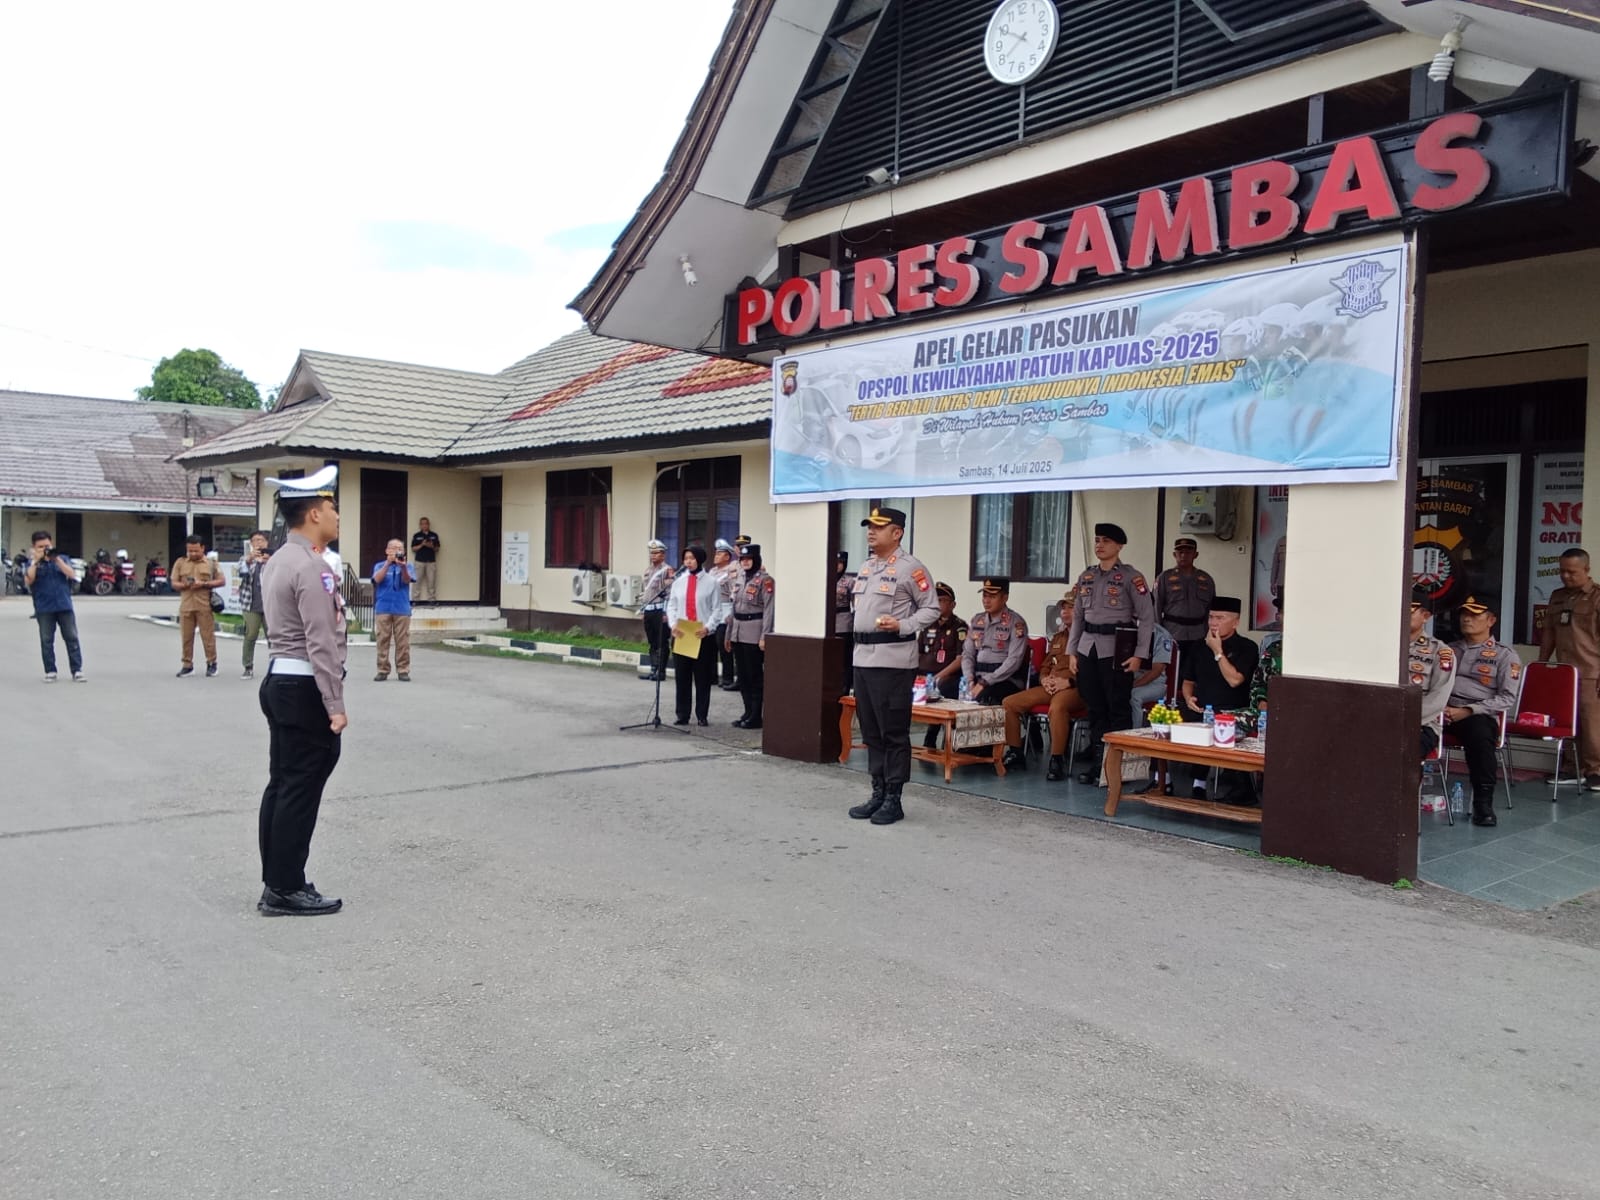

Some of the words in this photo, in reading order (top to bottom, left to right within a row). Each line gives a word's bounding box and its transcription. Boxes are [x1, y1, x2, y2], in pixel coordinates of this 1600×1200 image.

[1031, 3, 1036, 13] 1
[1038, 11, 1046, 23] 2
[1041, 24, 1049, 36] 3
[996, 40, 1003, 52] 9
[1037, 40, 1046, 51] 4
[998, 54, 1006, 65] 8
[1029, 54, 1037, 66] 5
[1008, 61, 1015, 73] 7
[1018, 62, 1025, 74] 6
[738, 236, 980, 345] POLRES
[999, 113, 1490, 295] SAMBAS
[914, 336, 957, 368] APEL
[961, 324, 1025, 362] GELAR
[1028, 306, 1139, 352] PASUKAN
[858, 375, 908, 401] OPSPOL
[911, 360, 1016, 394] KEWILAYAHAN
[1019, 351, 1074, 380] PATUH
[1077, 330, 1219, 372] KAPUAS-2025
[885, 399, 932, 418] BERLALU
[932, 394, 970, 414] LINTAS
[972, 388, 1005, 409] DEMI
[1006, 376, 1100, 404] TERWUJUDNYA
[1101, 367, 1186, 394] INDONESIA
[923, 419, 937, 434] Di
[937, 413, 981, 434] Wilayah
[981, 411, 1019, 429] Hukum
[1021, 408, 1057, 426] Polres
[1059, 400, 1109, 422] Sambas
[959, 465, 995, 479] Sambas,
[998, 464, 1008, 474] 14
[1010, 462, 1027, 474] Juli
[1029, 460, 1052, 473] 2025
[1431, 480, 1473, 492] SAMBAS
[1443, 502, 1472, 516] BARAT
